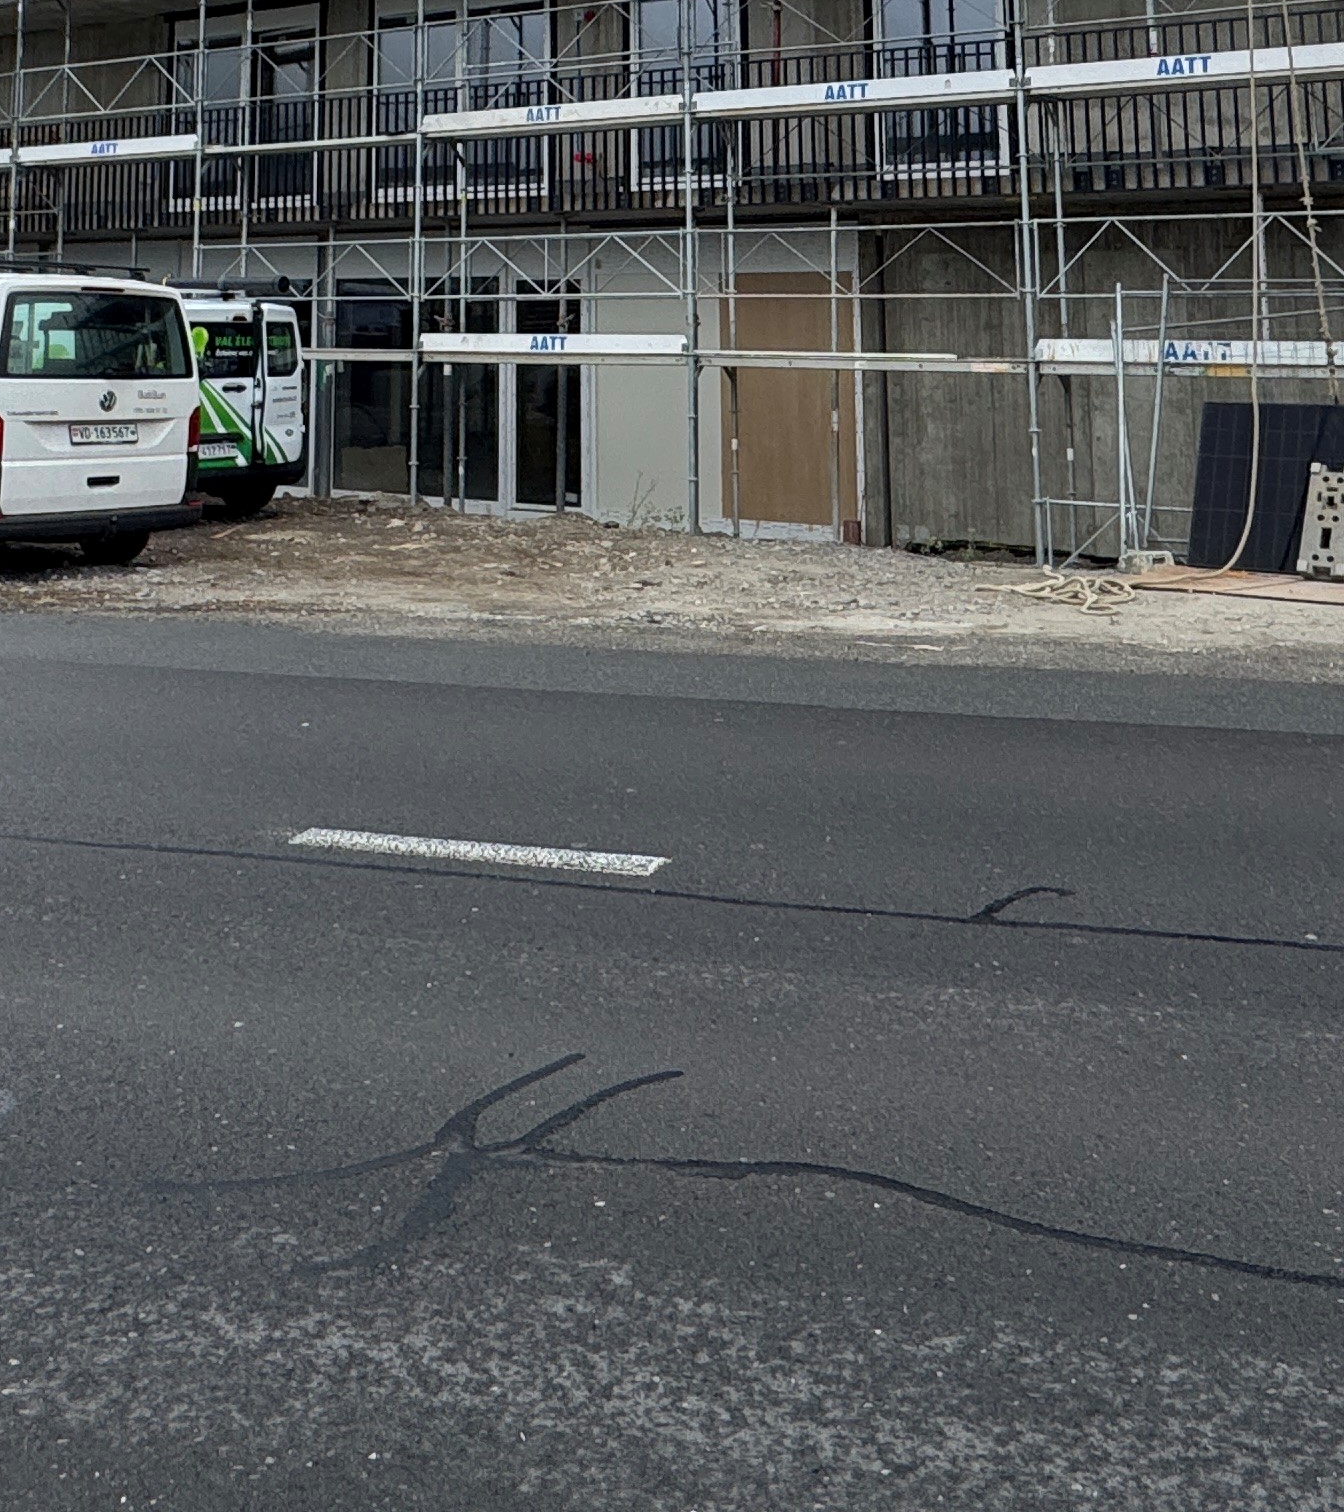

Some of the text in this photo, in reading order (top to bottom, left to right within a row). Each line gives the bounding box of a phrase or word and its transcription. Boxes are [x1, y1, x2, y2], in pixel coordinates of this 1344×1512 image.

[1156, 56, 1212, 76] AATT
[824, 83, 869, 101] AATT
[526, 106, 561, 123] AATT
[91, 143, 119, 155] AATT
[530, 335, 568, 351] AATT
